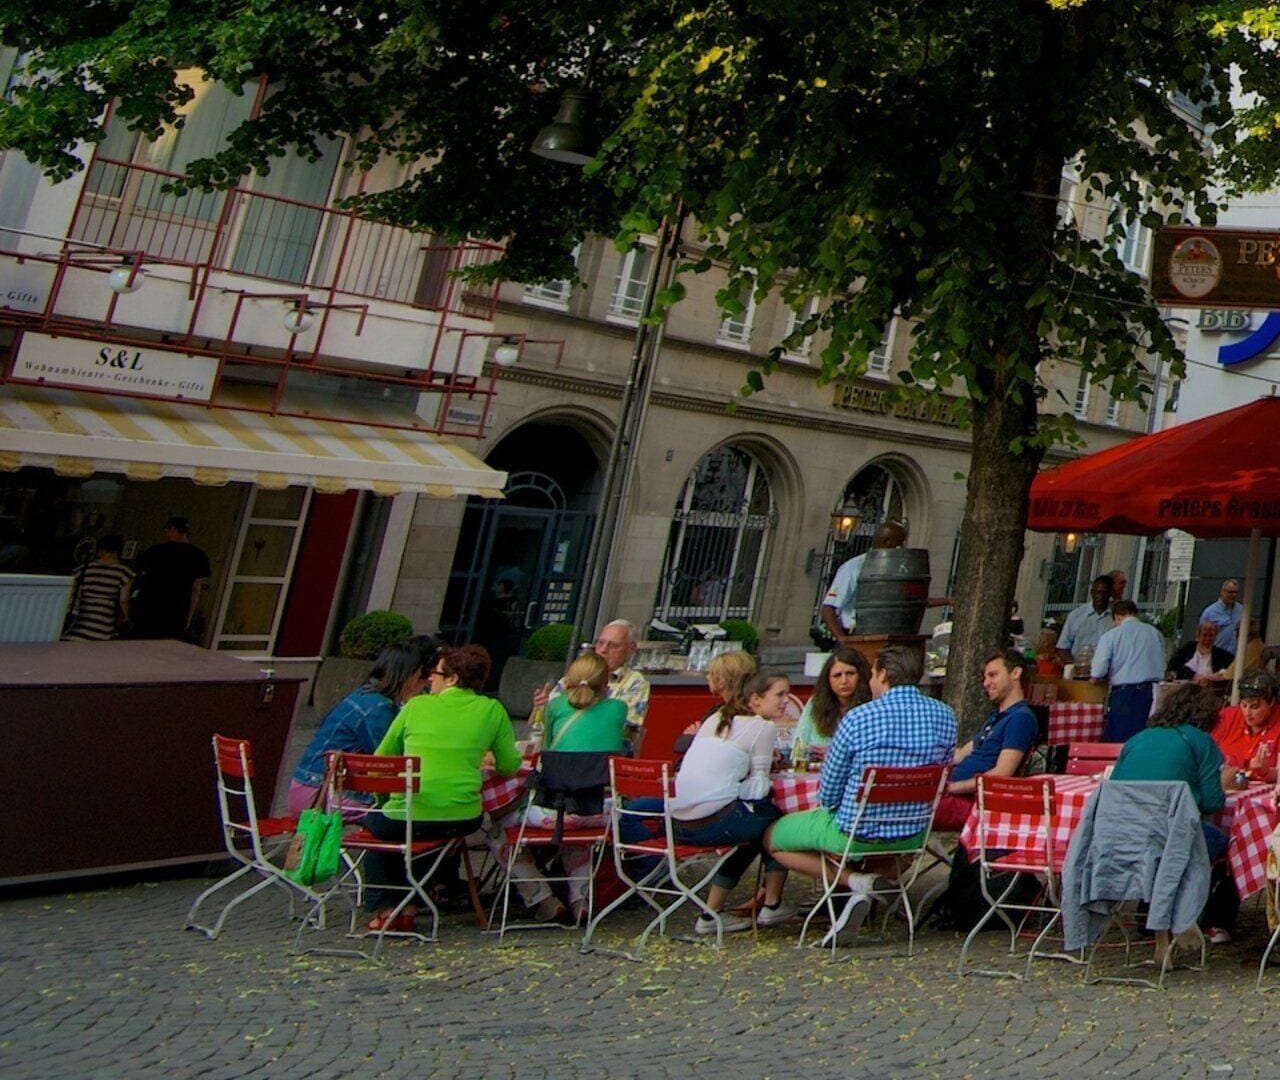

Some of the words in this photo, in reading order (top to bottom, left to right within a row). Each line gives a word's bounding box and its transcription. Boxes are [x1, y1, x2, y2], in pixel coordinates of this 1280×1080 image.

[1179, 263, 1213, 274] PETERS
[7, 290, 39, 304] Gifts
[94, 346, 145, 372] S&L
[23, 360, 105, 380] Wohnambiente
[113, 372, 170, 389] Geschenke
[178, 381, 206, 394] Gifts
[1158, 498, 1223, 519] Peters
